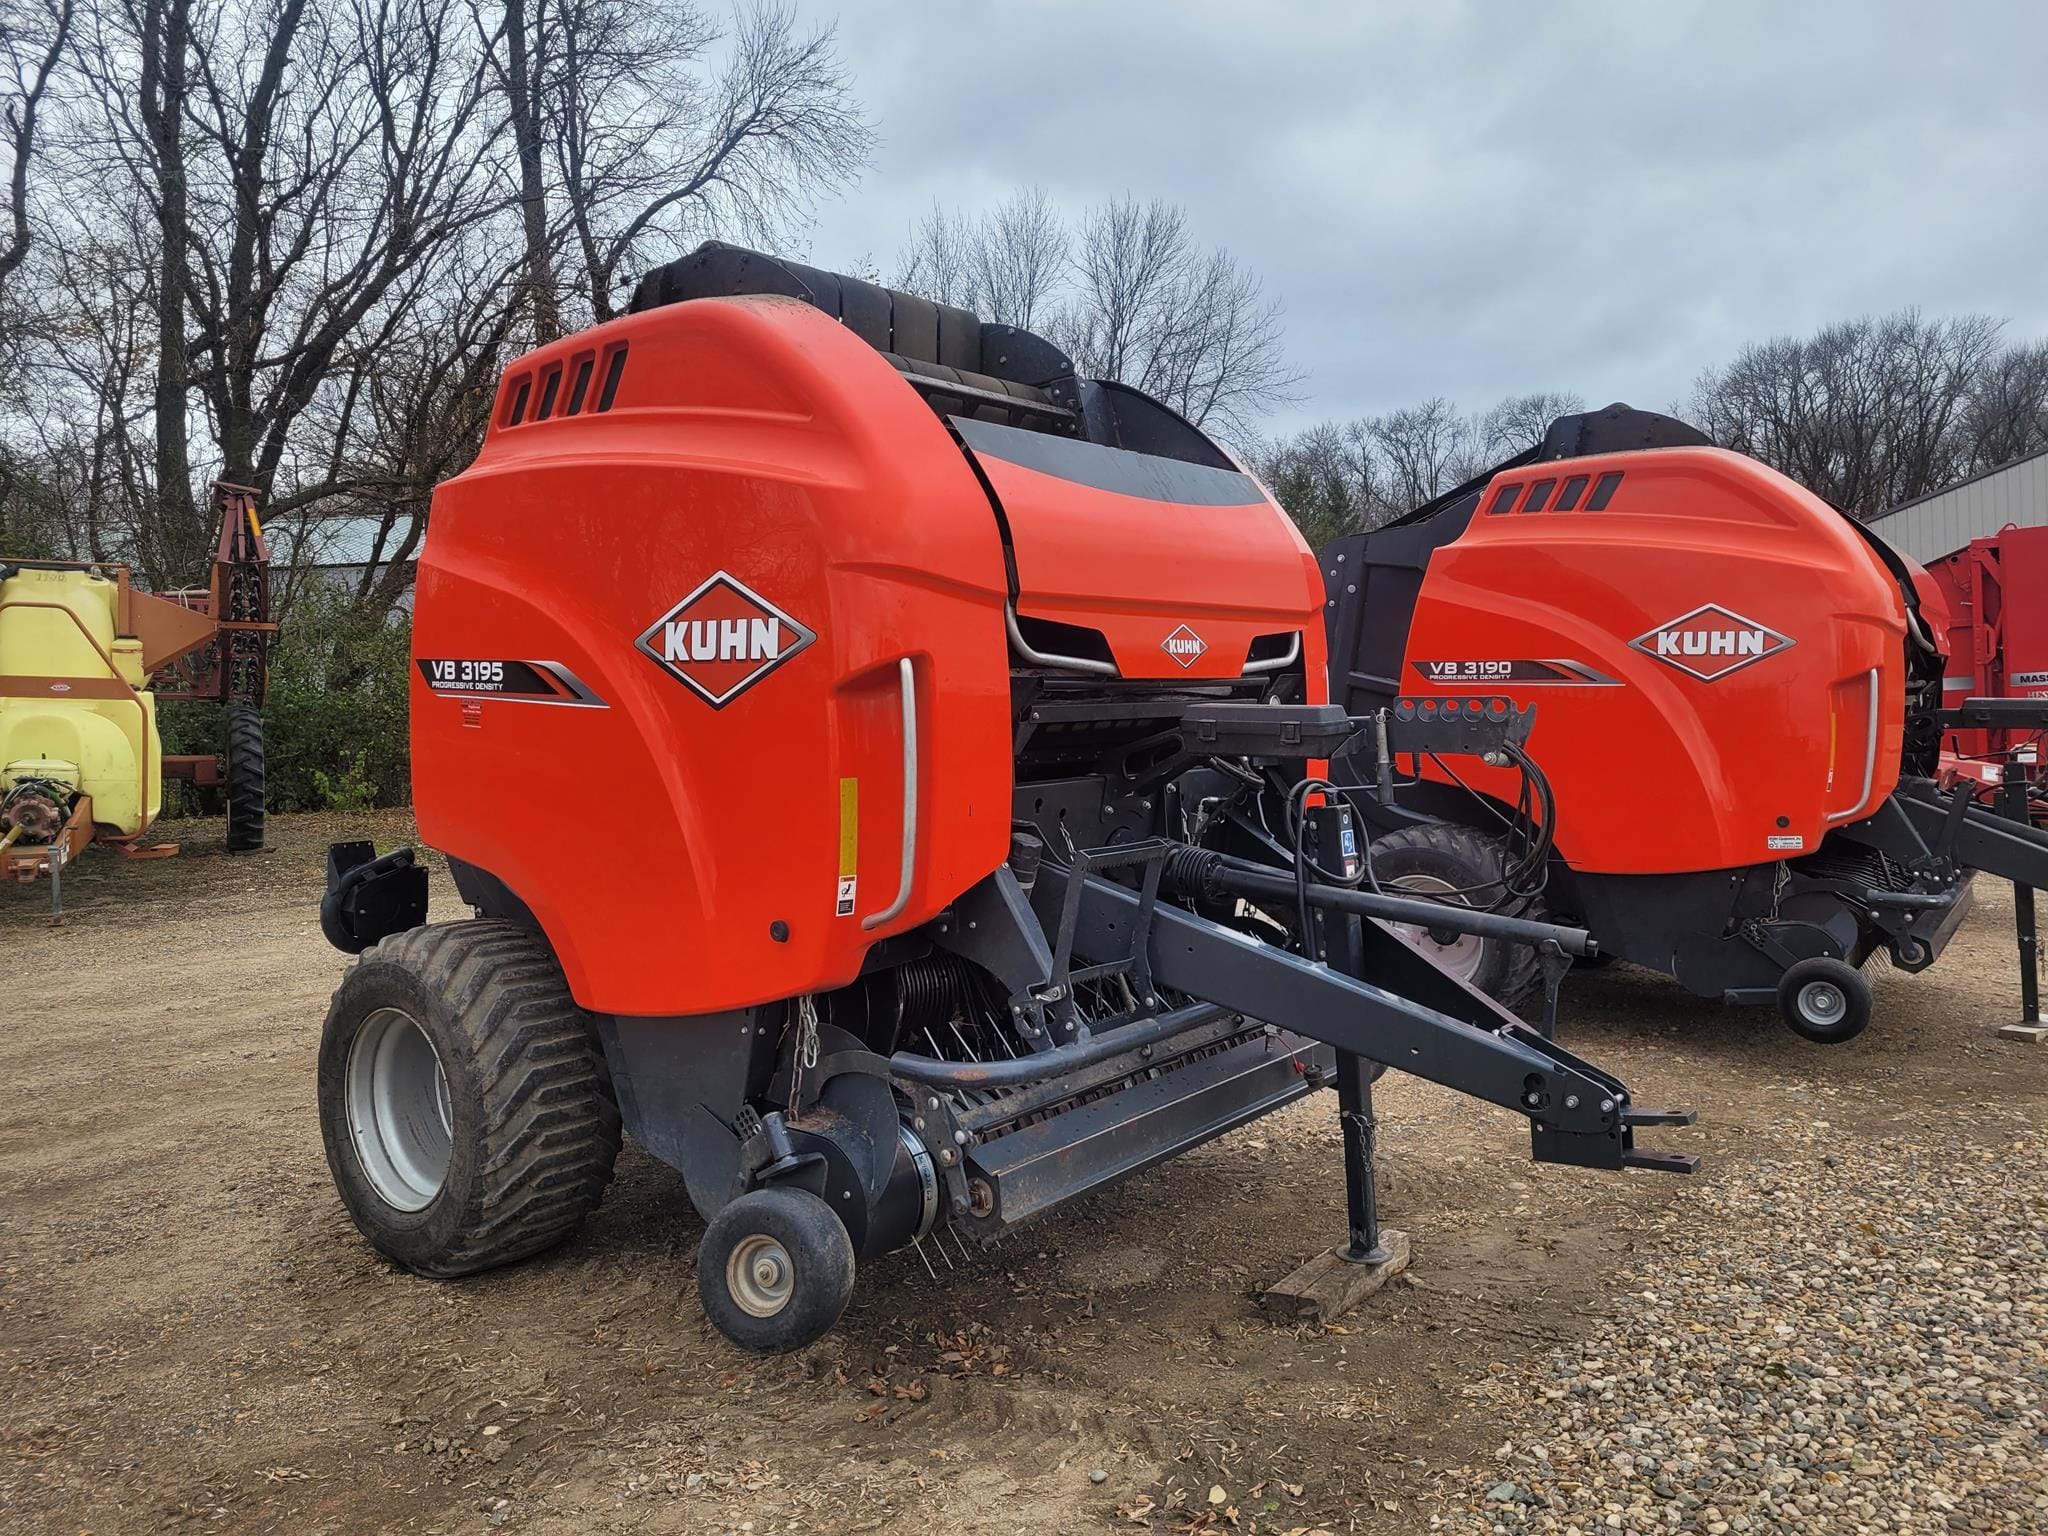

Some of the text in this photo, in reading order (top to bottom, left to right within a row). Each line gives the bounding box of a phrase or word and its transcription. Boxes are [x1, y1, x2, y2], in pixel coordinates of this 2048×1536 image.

[664, 617, 779, 662] KUHN
[1168, 639, 1200, 654] KUHN
[1657, 630, 1764, 656] KUHN
[431, 660, 504, 682] VB 3195
[1429, 661, 1512, 675] VB 3190
[431, 680, 504, 691] PROGRESSIVE DENSITY
[2020, 674, 2048, 683] MAS
